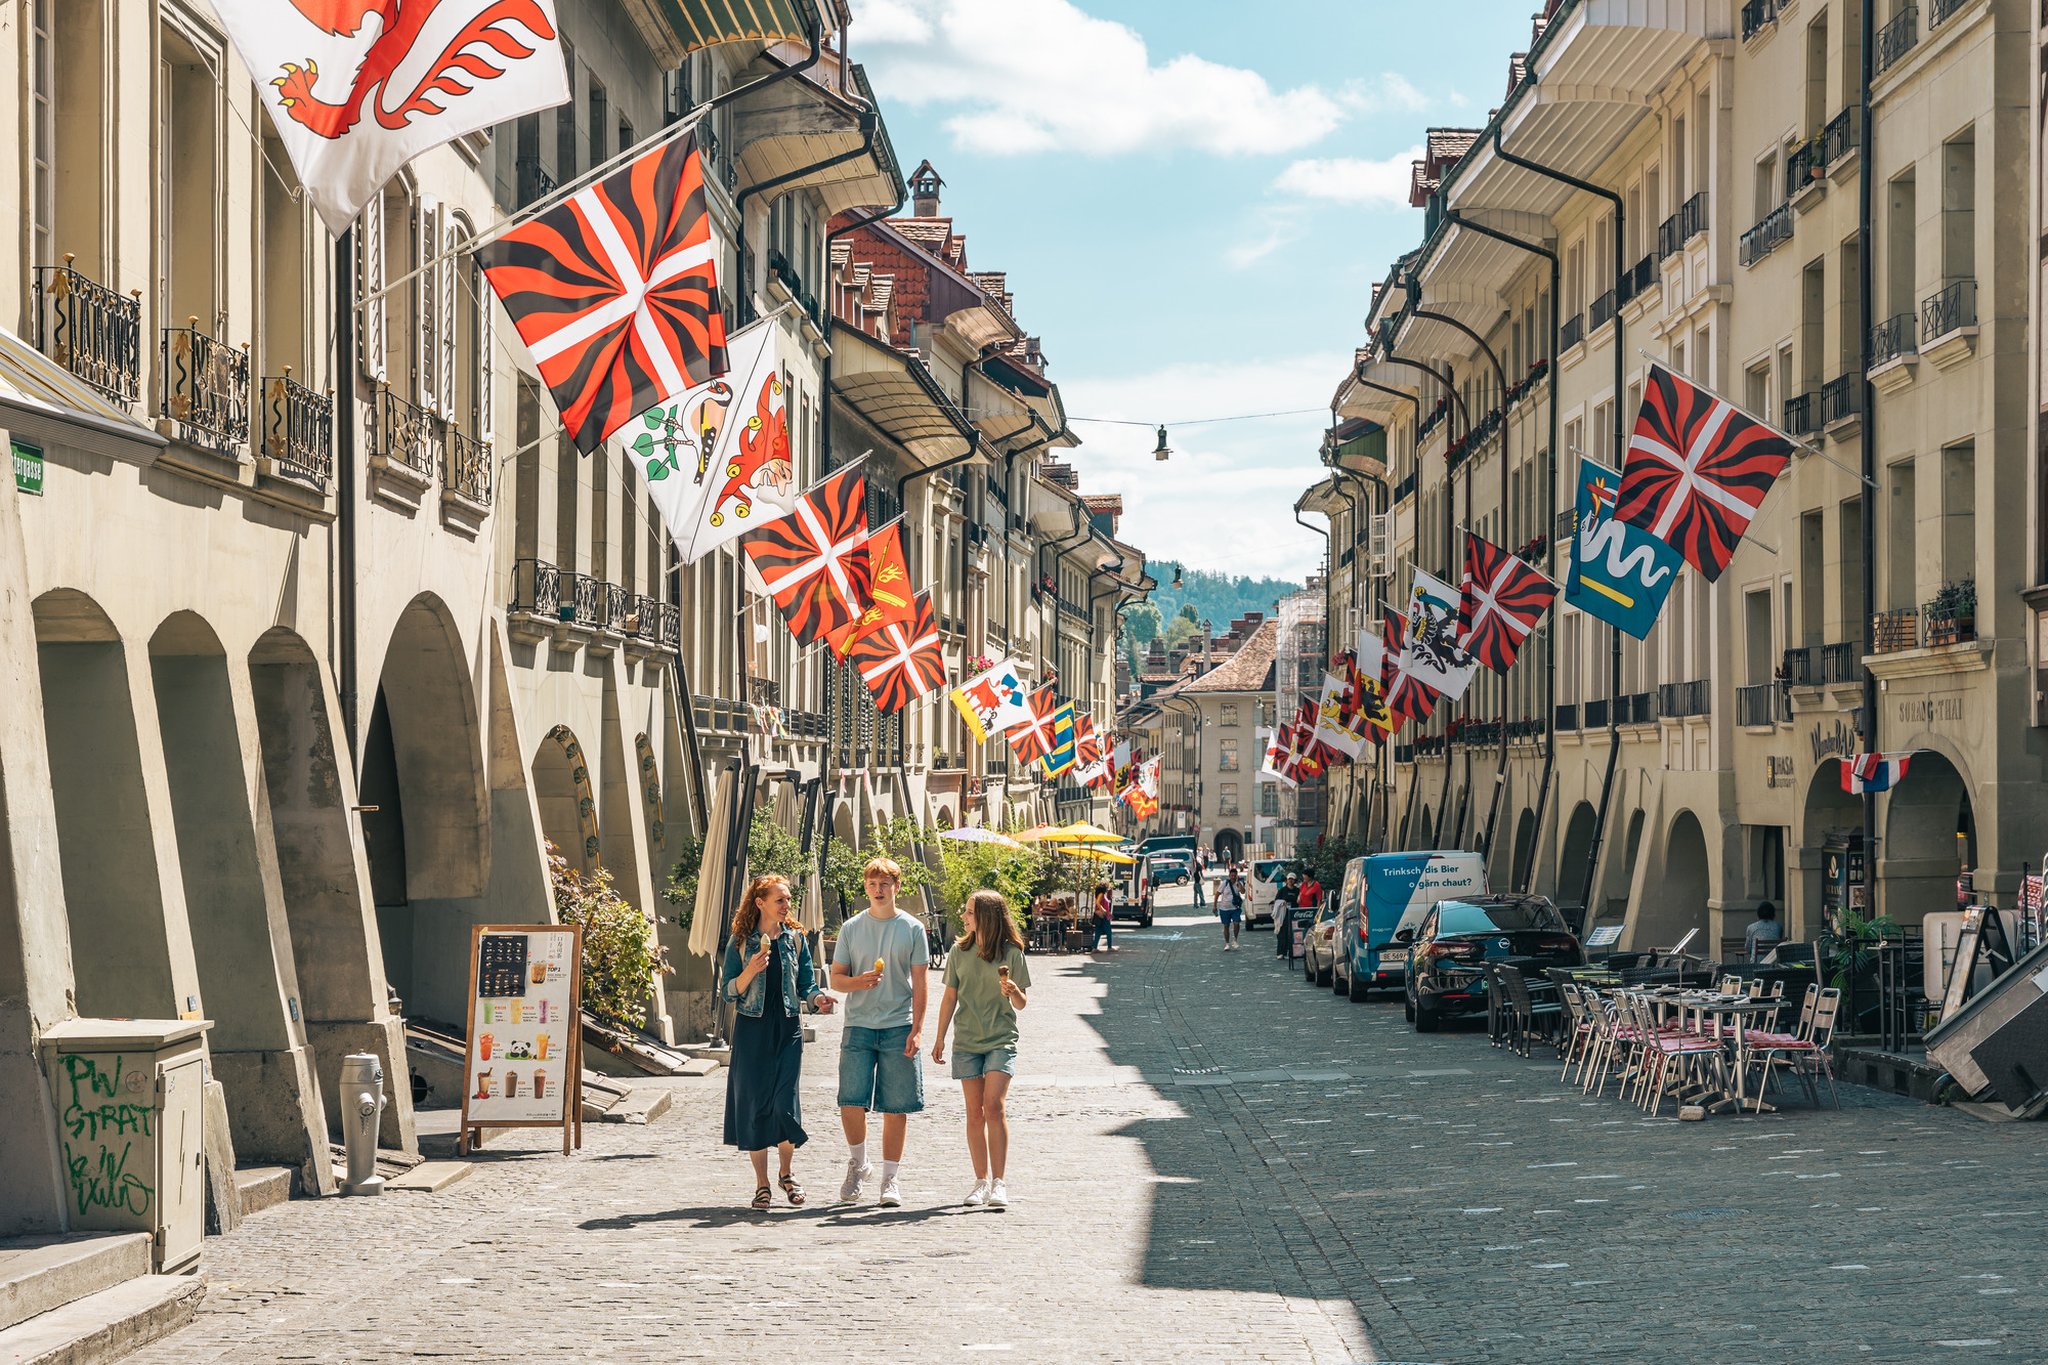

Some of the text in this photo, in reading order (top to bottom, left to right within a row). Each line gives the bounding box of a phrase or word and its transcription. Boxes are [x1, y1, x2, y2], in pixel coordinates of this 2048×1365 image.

[1937, 698, 1962, 721] THAI
[1383, 864, 1459, 876] Trinksch dis Bier
[1418, 878, 1440, 889] gärn
[1442, 877, 1472, 887] chaut?
[64, 1103, 155, 1141] STRAT
